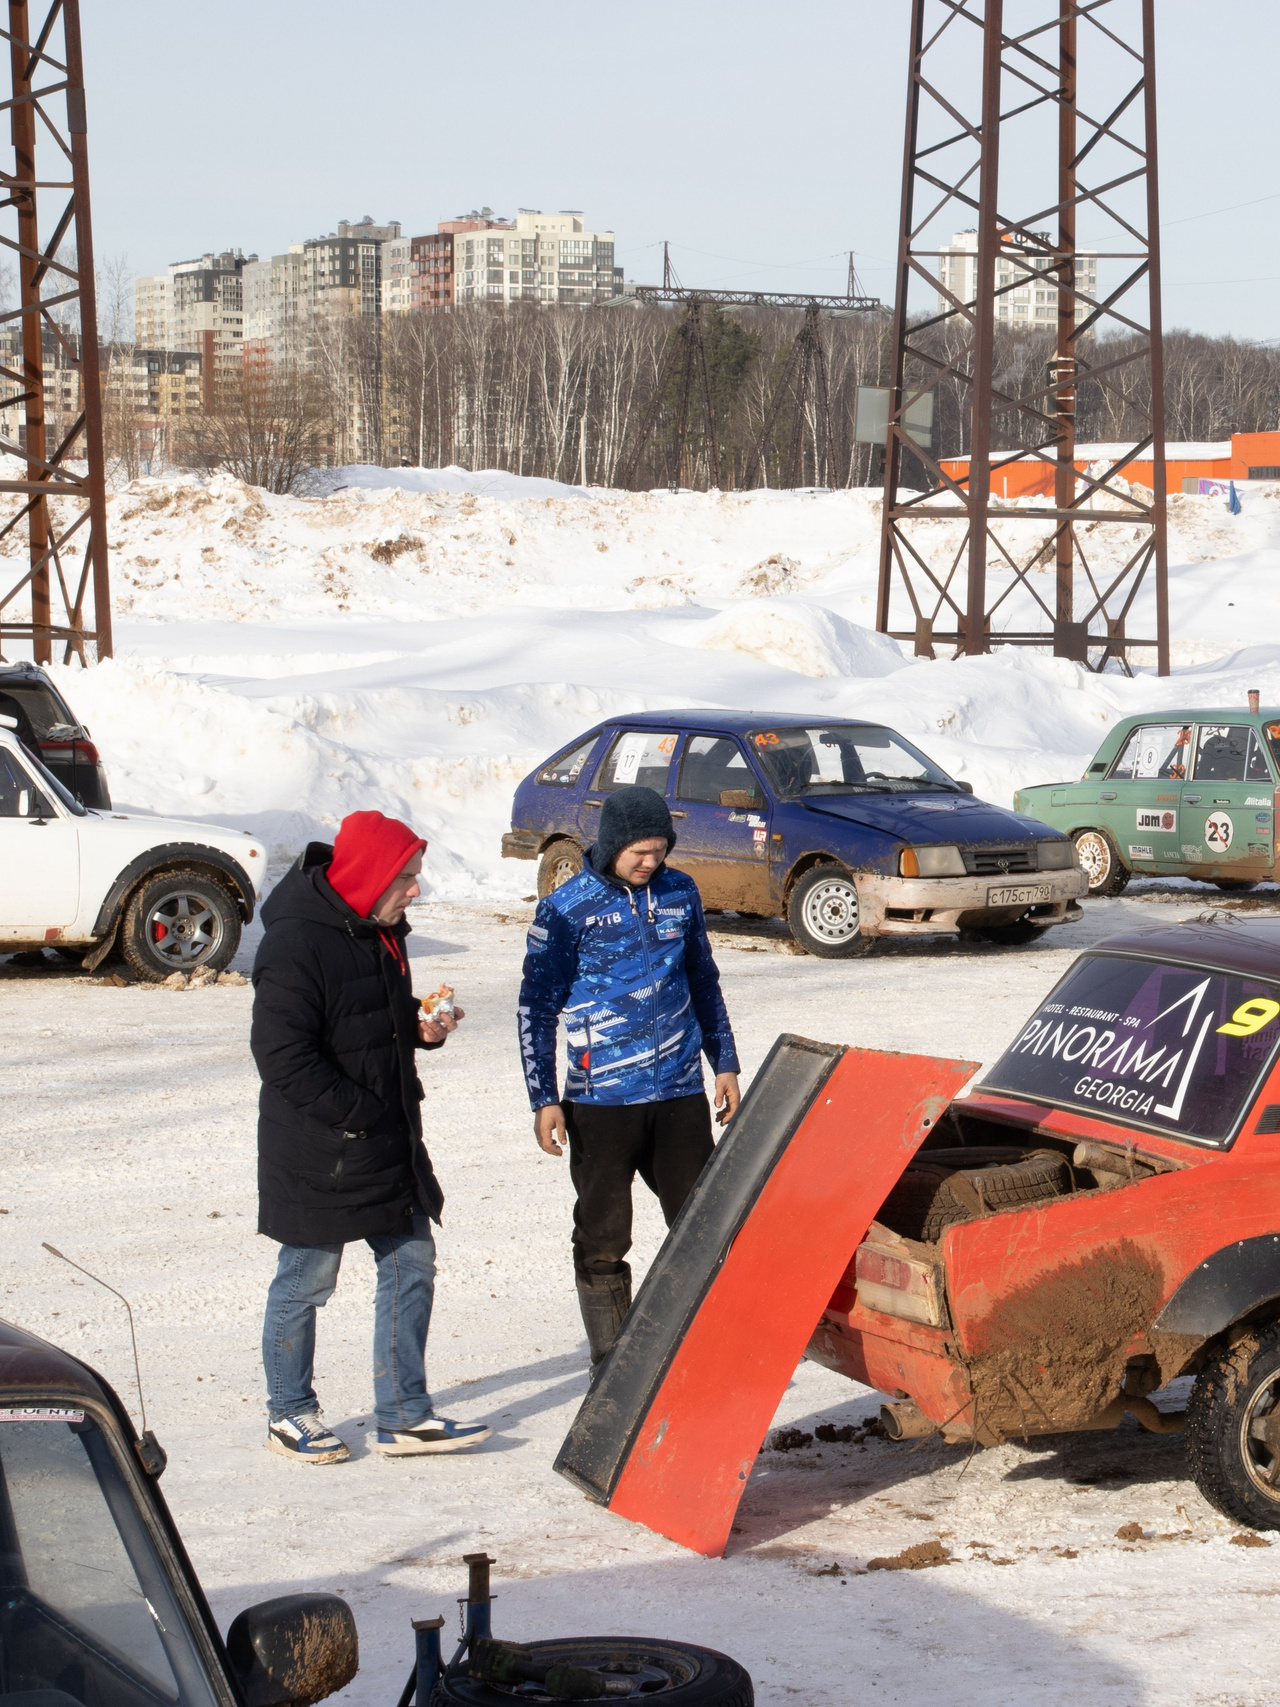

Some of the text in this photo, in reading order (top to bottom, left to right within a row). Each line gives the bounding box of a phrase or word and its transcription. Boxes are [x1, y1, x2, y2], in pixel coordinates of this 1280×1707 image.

[657, 737, 676, 754] 43
[754, 732, 780, 746] 43
[624, 754, 636, 768] 17
[1147, 752, 1153, 764] 8
[1244, 797, 1272, 806] Alitalia
[1138, 815, 1160, 827] JDM
[1207, 822, 1230, 842] 23
[991, 886, 1050, 904] С175СТ 790
[597, 912, 622, 927] VTB
[1043, 1004, 1064, 1014] HOTEL
[1068, 1006, 1120, 1023] RESTAURANT
[1123, 1016, 1141, 1029] SPA
[1215, 998, 1280, 1037] 9
[1010, 1019, 1183, 1088] PANORAMA
[1073, 1076, 1155, 1116] GEORGIA
[10, 1408, 84, 1417] EVENTS
